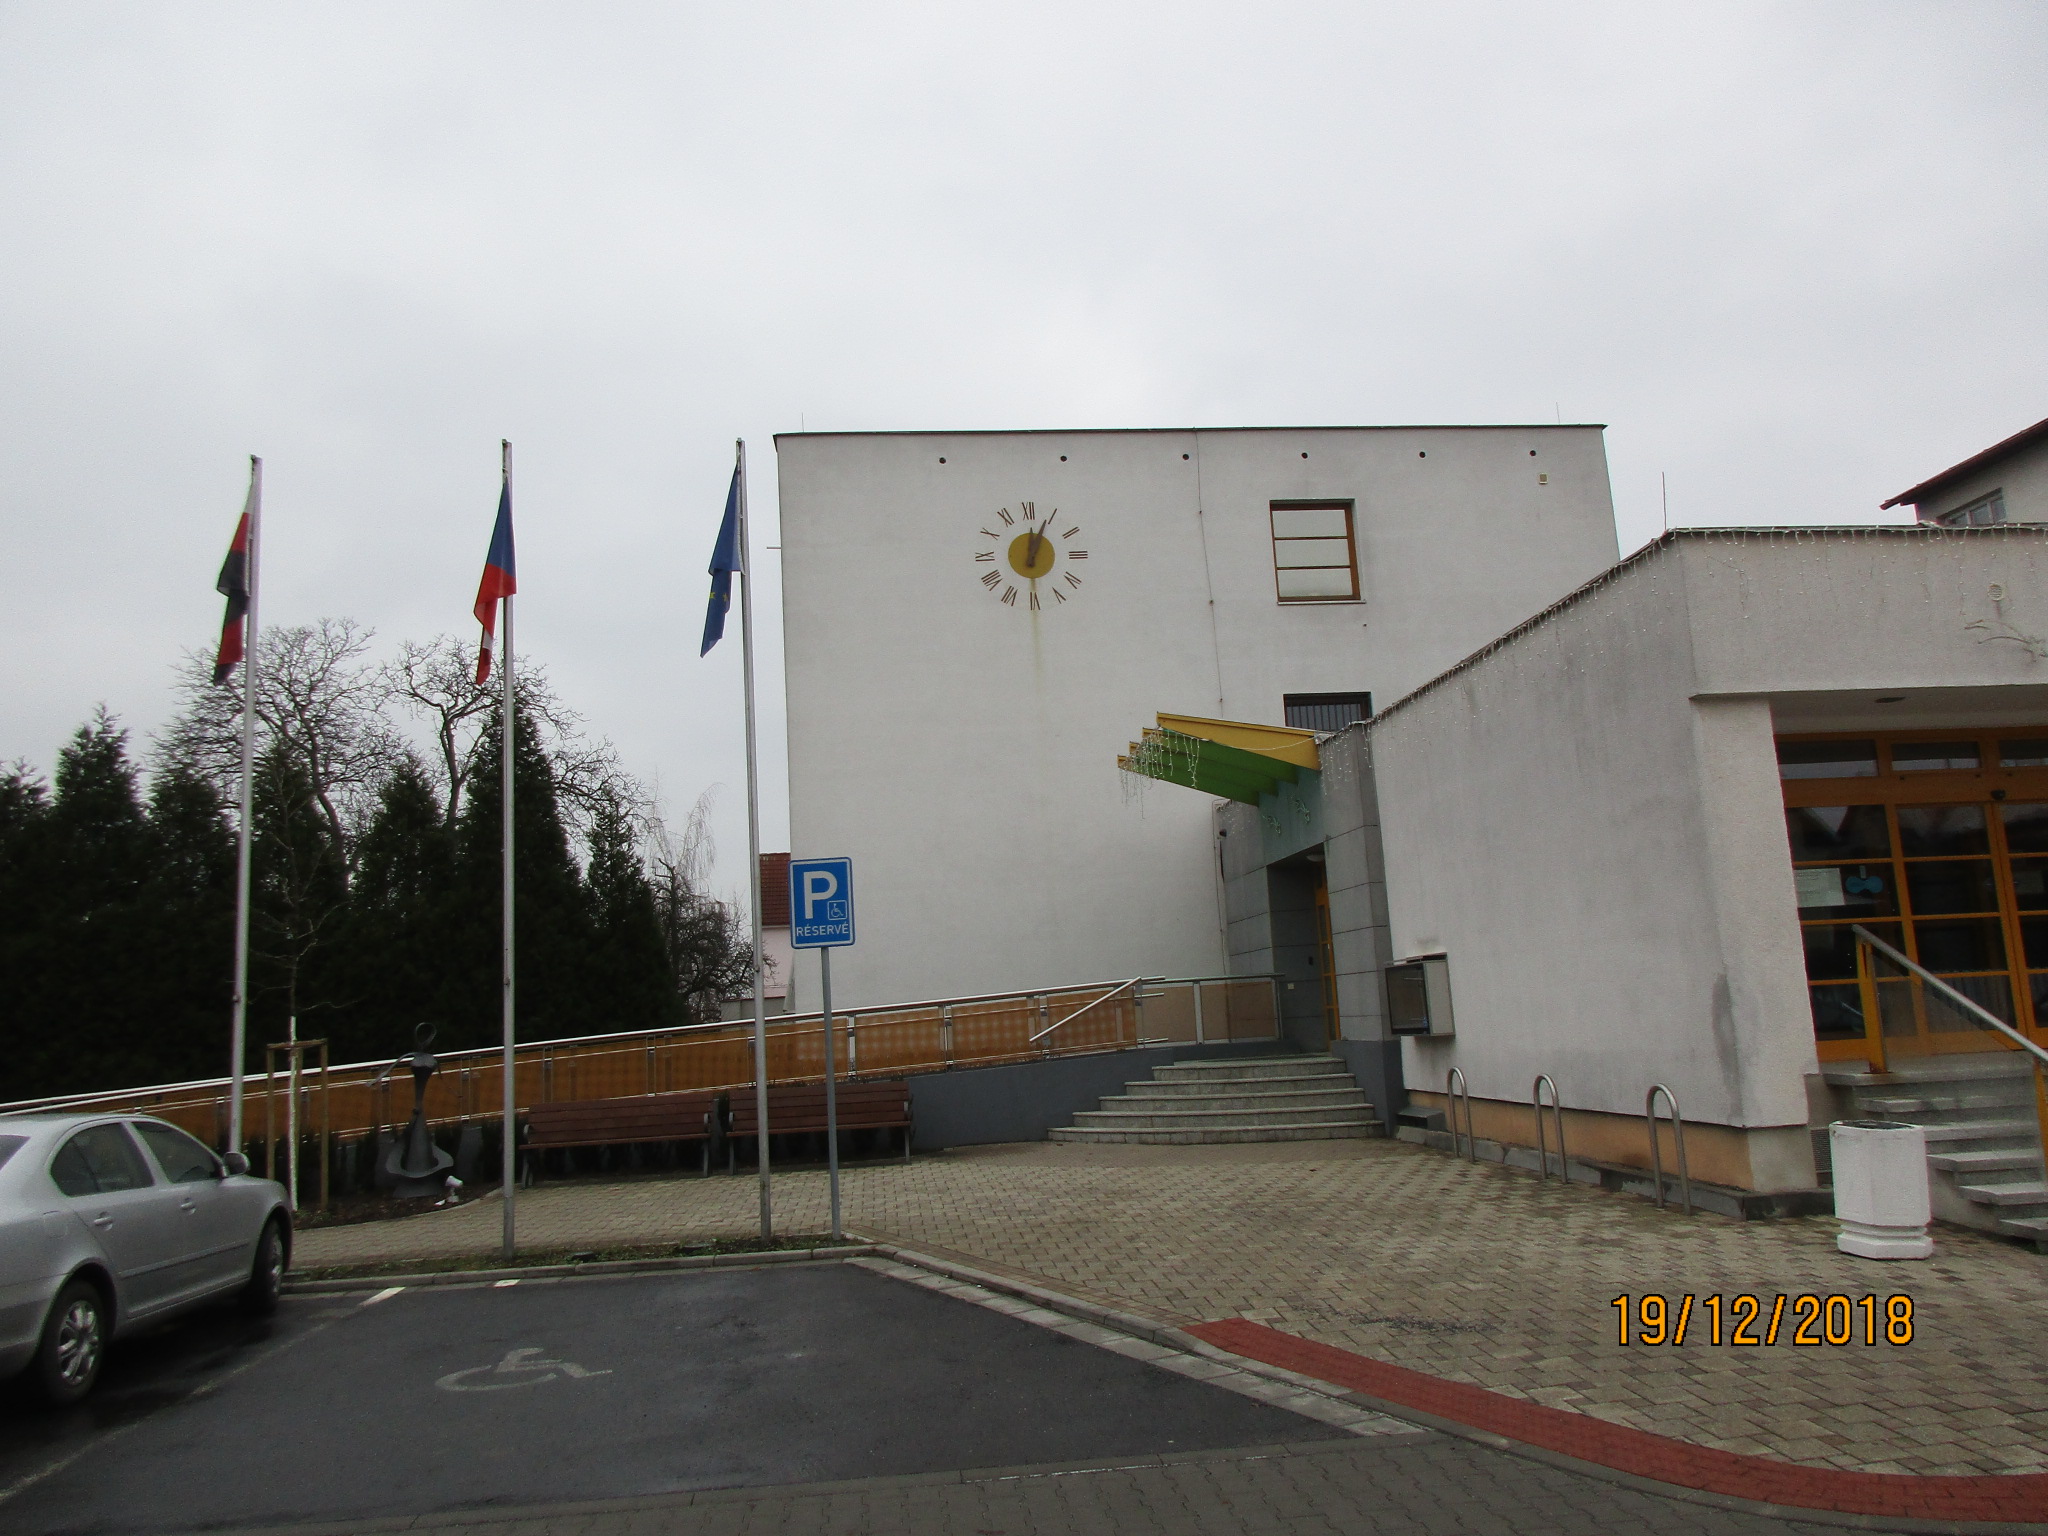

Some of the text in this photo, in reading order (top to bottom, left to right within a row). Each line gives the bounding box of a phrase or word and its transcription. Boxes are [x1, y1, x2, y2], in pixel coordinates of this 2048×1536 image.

[997, 507, 1015, 528] XI
[1021, 501, 1035, 521] XII
[1062, 526, 1080, 539] II
[974, 551, 995, 562] IX
[1068, 550, 1089, 560] III
[980, 569, 1003, 591] VIII
[1063, 571, 1082, 590] IV
[1000, 585, 1018, 607] VII
[1029, 591, 1041, 611] VI
[803, 871, 837, 919] P
[797, 922, 849, 936] RÉSERVÉ
